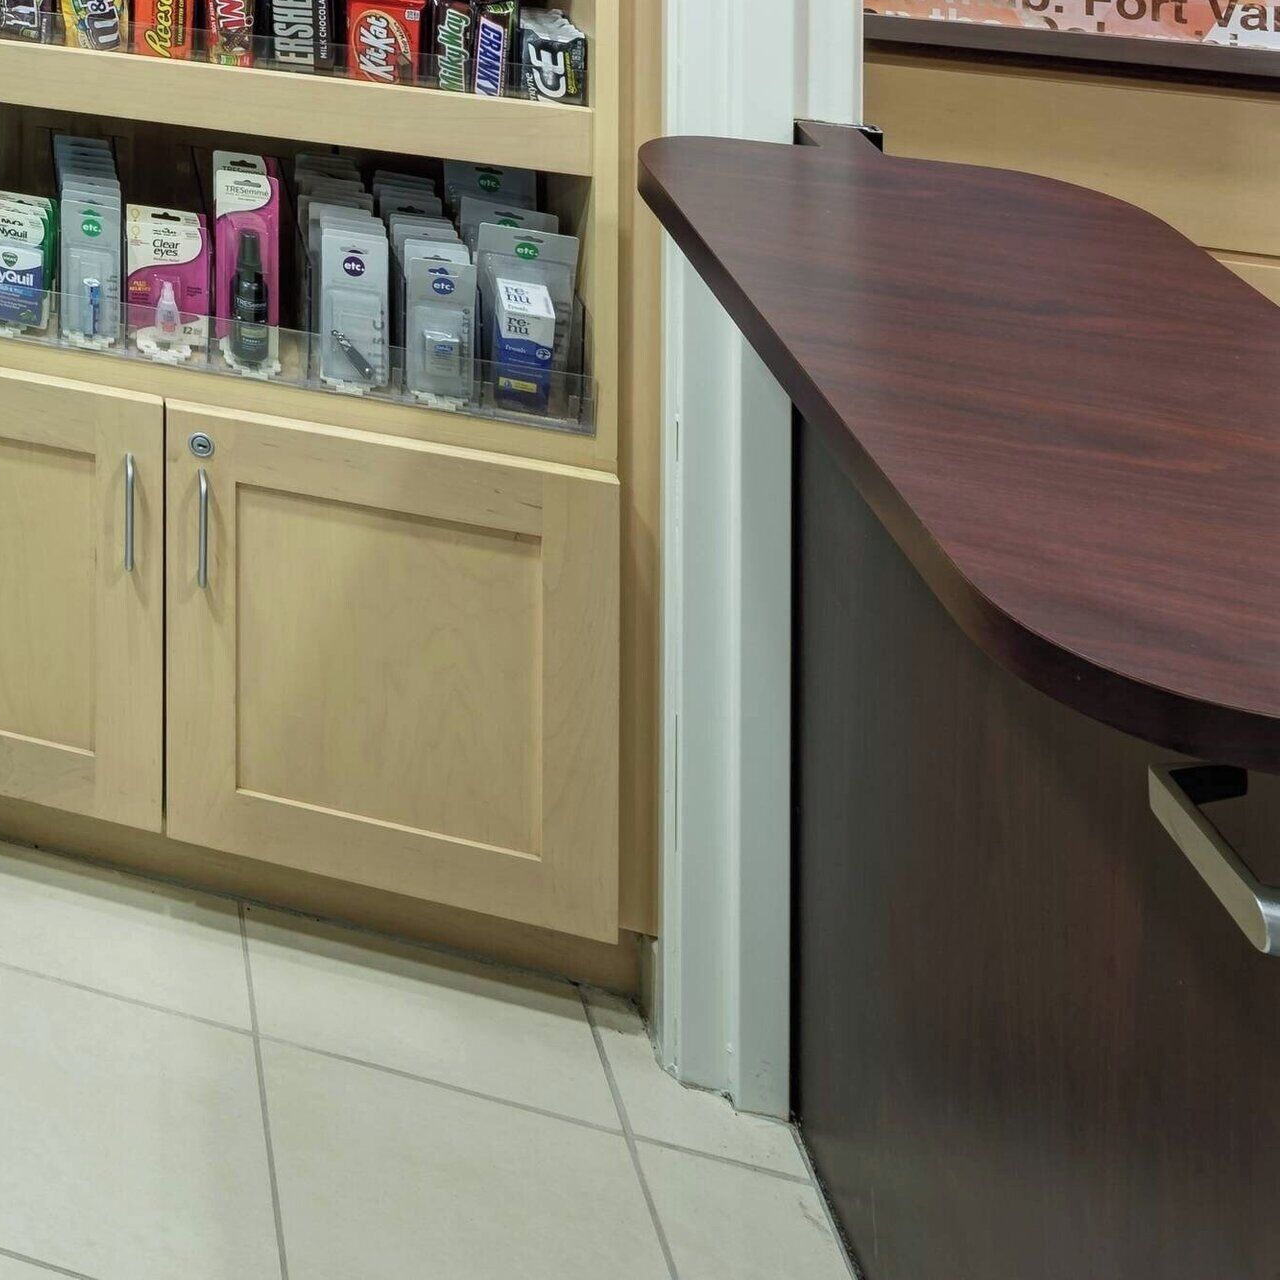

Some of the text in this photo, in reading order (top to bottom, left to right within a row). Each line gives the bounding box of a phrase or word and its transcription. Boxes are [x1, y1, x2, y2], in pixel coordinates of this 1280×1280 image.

[320, 38, 328, 60] MILK
[82, 222, 101, 232] etc.
[152, 238, 180, 249] Clear
[153, 246, 178, 257] eyes
[516, 246, 539, 256] etc.
[345, 260, 364, 272] etc.
[434, 281, 454, 292] etc.
[507, 294, 532, 305] nu
[507, 325, 530, 335] nu
